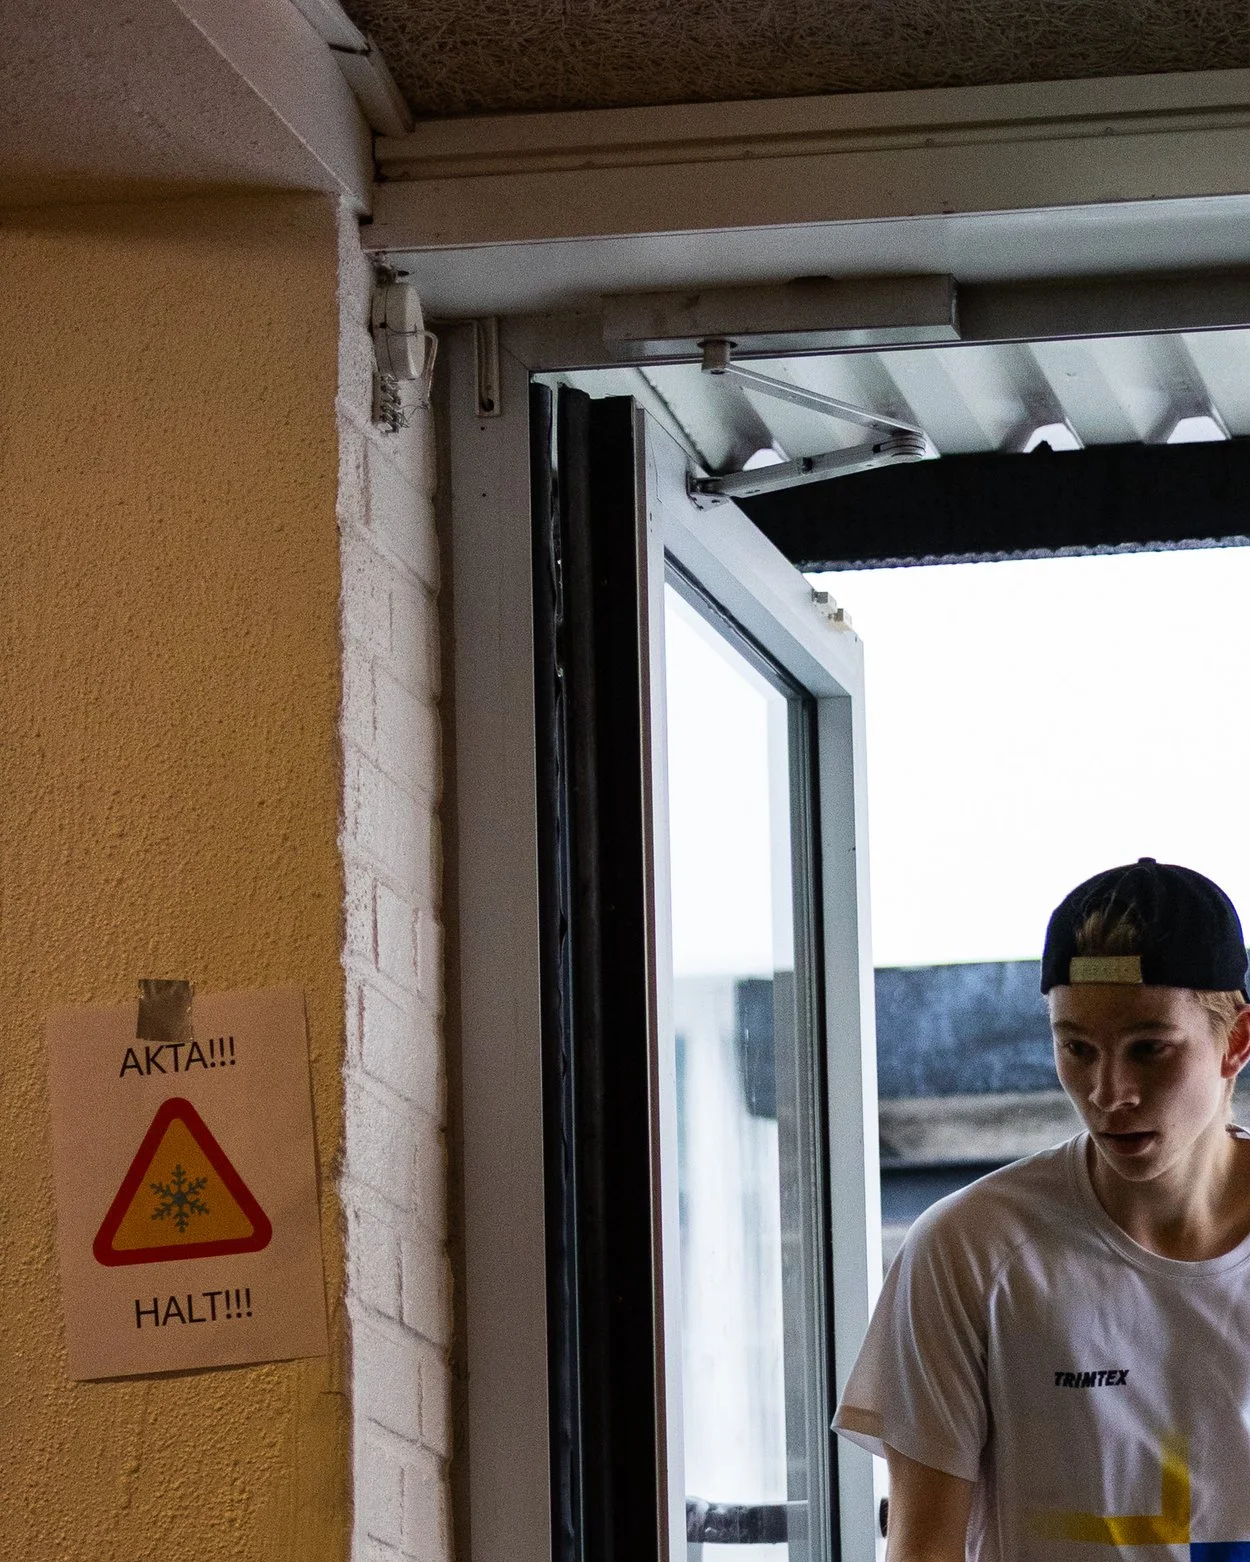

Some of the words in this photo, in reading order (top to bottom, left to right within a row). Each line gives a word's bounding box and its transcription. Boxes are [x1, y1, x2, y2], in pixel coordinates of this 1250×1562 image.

[119, 1036, 237, 1077] AKTA!!!
[134, 1288, 253, 1328] HALT!!!
[1054, 1369, 1129, 1388] TRIMTEX
